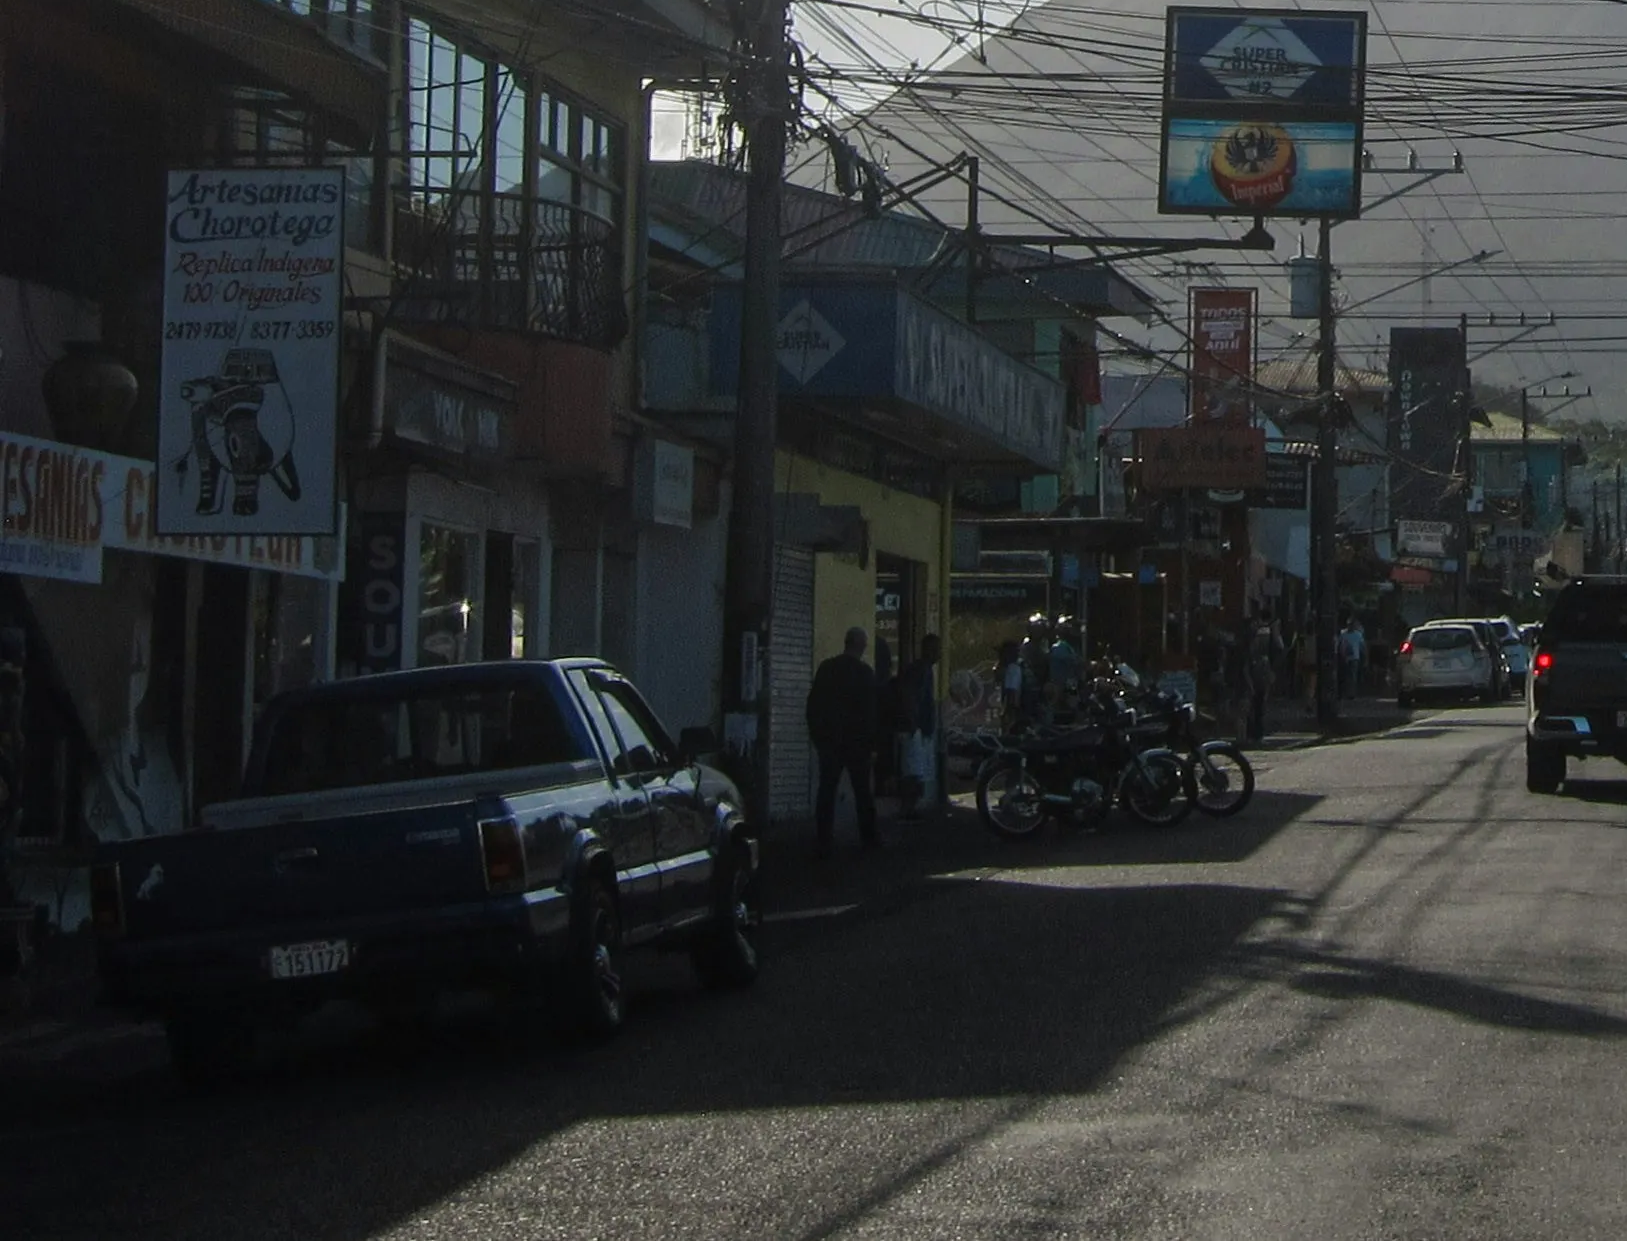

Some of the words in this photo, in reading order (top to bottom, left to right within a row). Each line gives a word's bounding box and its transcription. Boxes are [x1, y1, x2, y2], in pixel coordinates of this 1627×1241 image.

[1233, 47, 1287, 61] SUPER
[168, 172, 338, 206] Artesanias
[1230, 173, 1286, 204] Imperial
[169, 206, 336, 247] Chorotega
[0, 442, 104, 542] ESANIAS
[364, 534, 401, 676] SOU
